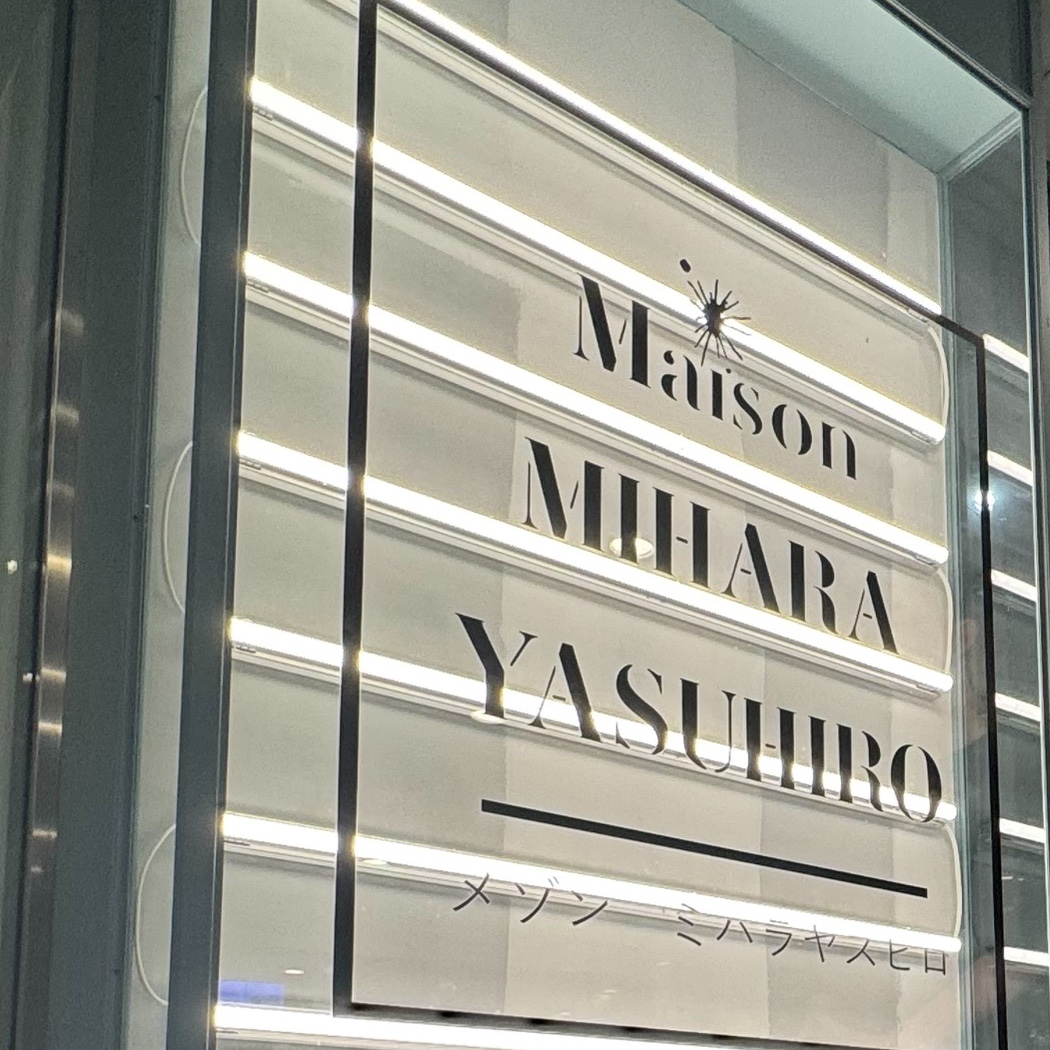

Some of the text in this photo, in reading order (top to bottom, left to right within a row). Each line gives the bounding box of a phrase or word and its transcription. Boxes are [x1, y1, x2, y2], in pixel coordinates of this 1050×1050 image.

[573, 273, 858, 481] Maison
[519, 436, 899, 654] MIHARA
[455, 612, 944, 824] YASUHIRO
[453, 873, 948, 976] メゾン ミハラヤスヒロ
